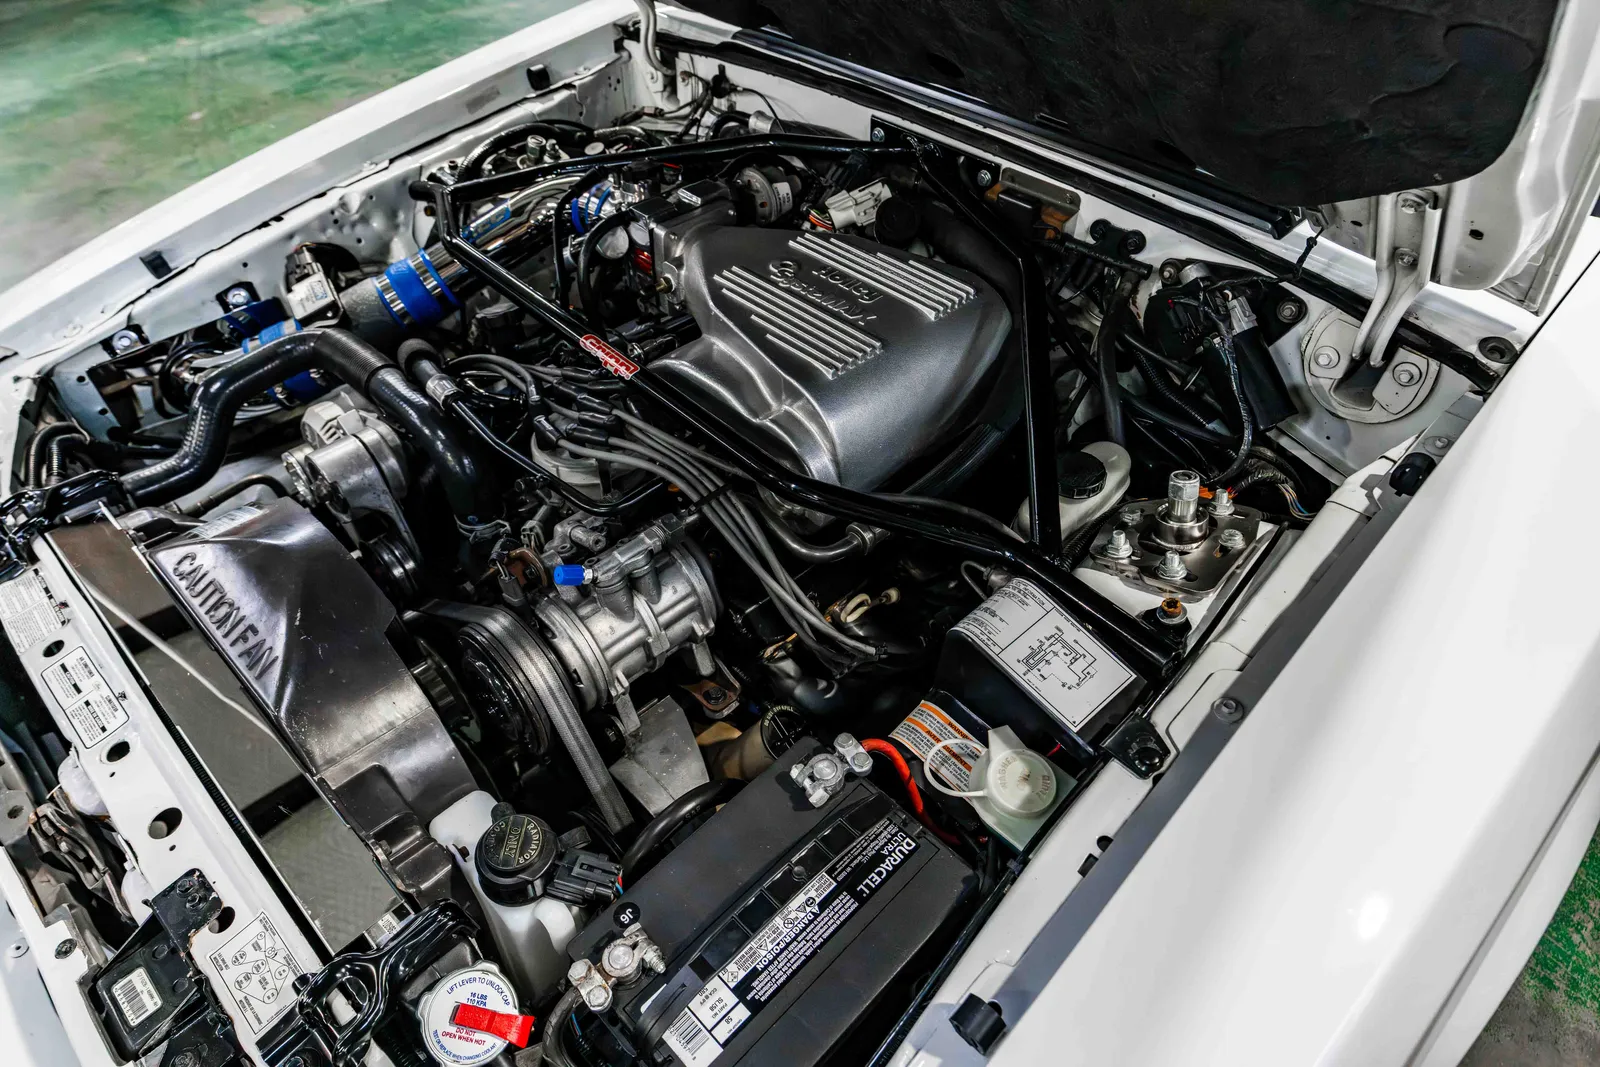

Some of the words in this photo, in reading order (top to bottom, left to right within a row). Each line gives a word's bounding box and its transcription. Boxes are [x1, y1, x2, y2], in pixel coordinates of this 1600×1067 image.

[811, 266, 883, 304] Holley
[172, 552, 246, 638] CAUTION
[228, 622, 278, 679] FAN
[504, 827, 519, 858] ONLY
[518, 823, 540, 863] RADIATOR
[880, 831, 905, 856] ULTRA
[856, 836, 916, 896] DURACELL
[618, 907, 636, 924] J6
[755, 911, 814, 971] DANGER/POISON
[446, 981, 457, 994] LIFT
[457, 977, 476, 987] LEVER
[485, 978, 504, 996] UNLOCK
[501, 993, 510, 1006] CAP
[476, 999, 487, 1007] KPA
[707, 986, 717, 996] CCA
[716, 1002, 727, 1013] PART
[724, 1015, 733, 1024] 58
[441, 1030, 456, 1039] OPEN
[457, 1034, 473, 1043] WHEN
[473, 1038, 486, 1046] HOT
[439, 1044, 452, 1057] REPLACE
[451, 1052, 462, 1060] WHEN
[463, 1052, 481, 1060] CHANGING
[481, 1042, 497, 1056] COOLANT
